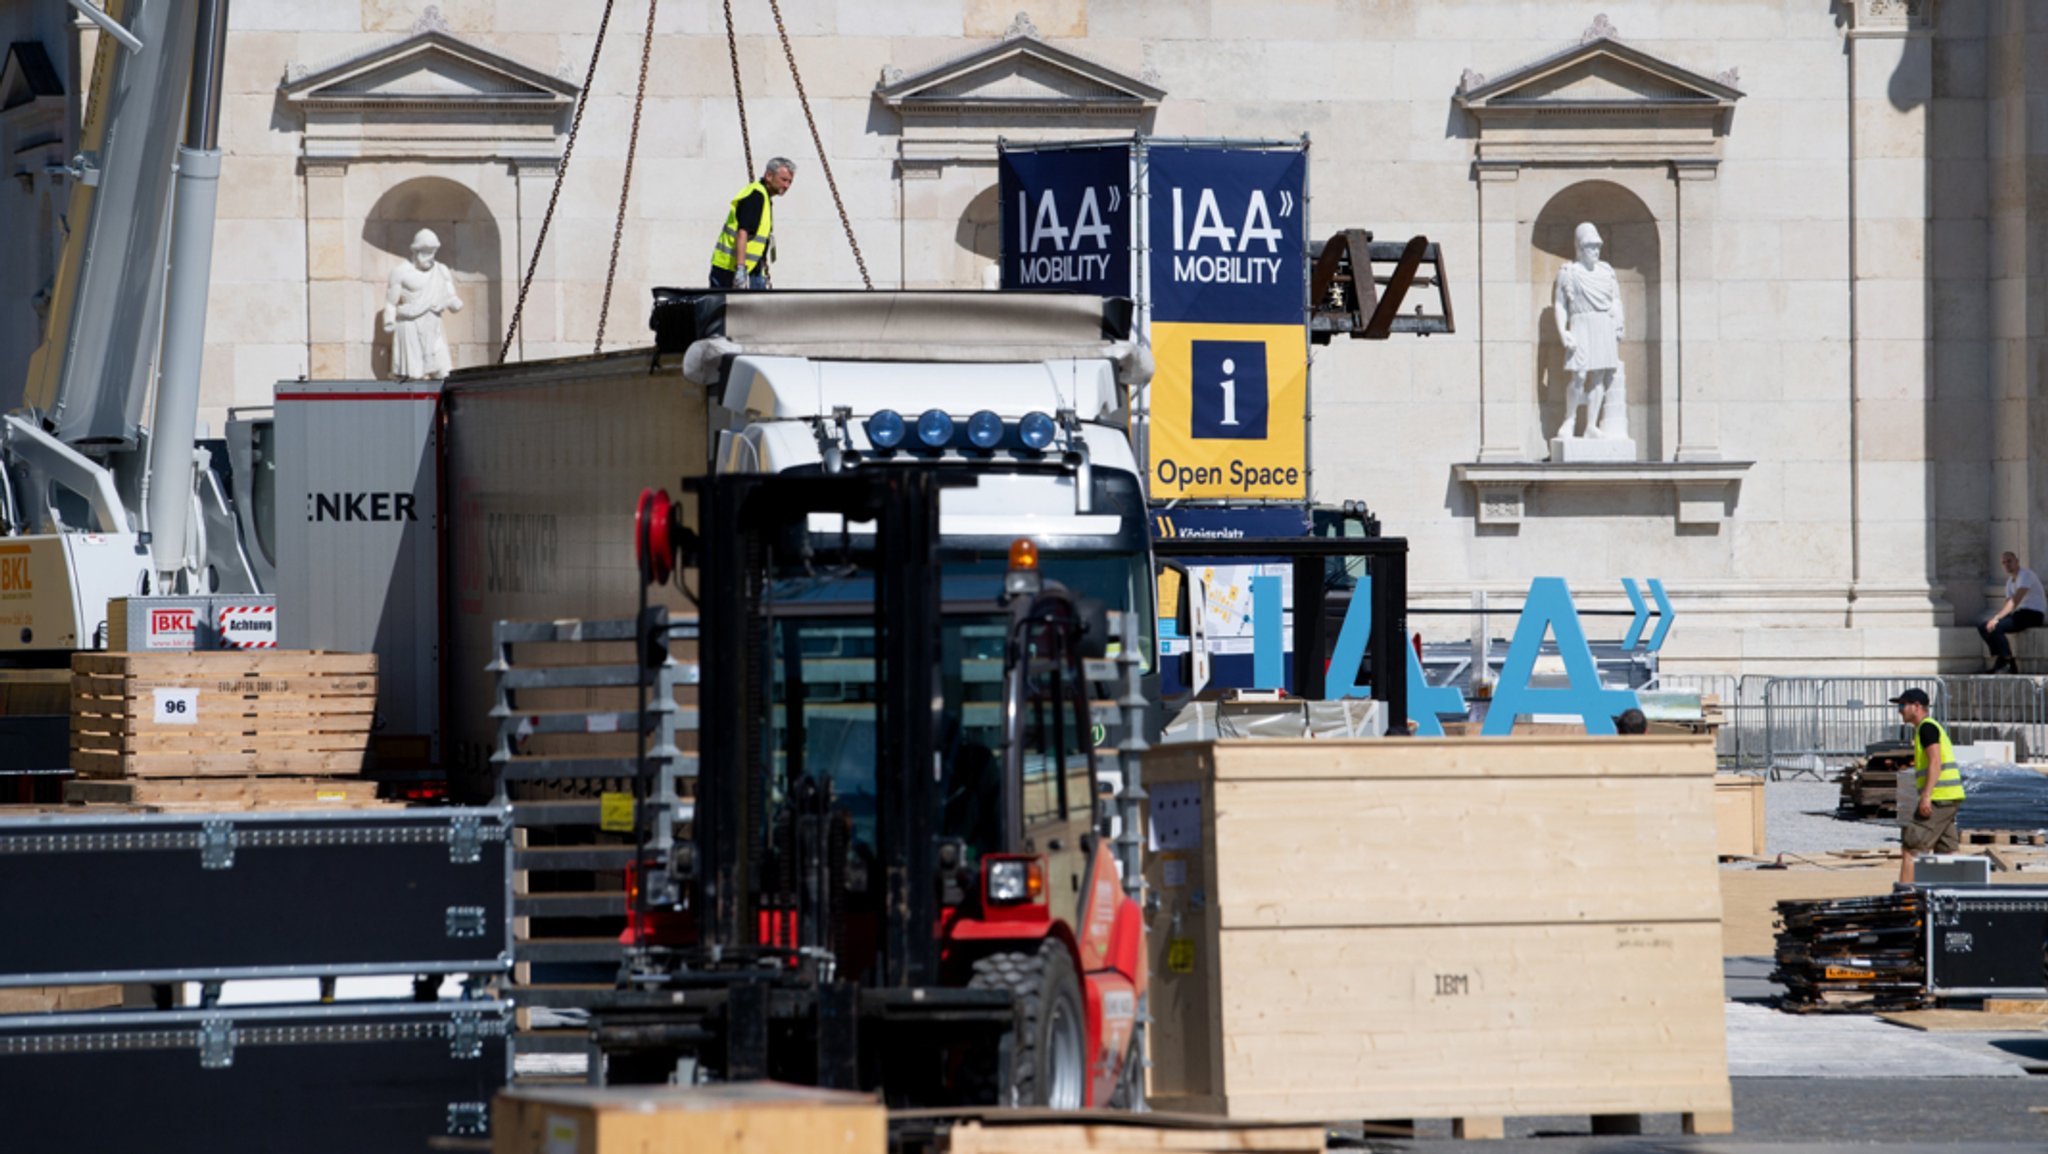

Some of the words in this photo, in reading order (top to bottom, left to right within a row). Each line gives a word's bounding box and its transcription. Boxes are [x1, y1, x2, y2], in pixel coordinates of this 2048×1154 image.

[1020, 255, 1110, 284] MOBILITY
[1174, 256, 1282, 283] MOBILITY
[1157, 459, 1222, 490] Open
[1230, 460, 1298, 491] Space
[1, 557, 33, 591] BKL
[158, 615, 197, 631] BKL
[230, 619, 272, 631] Achtung
[165, 699, 186, 715] 96
[1434, 973, 1468, 995] IBM
